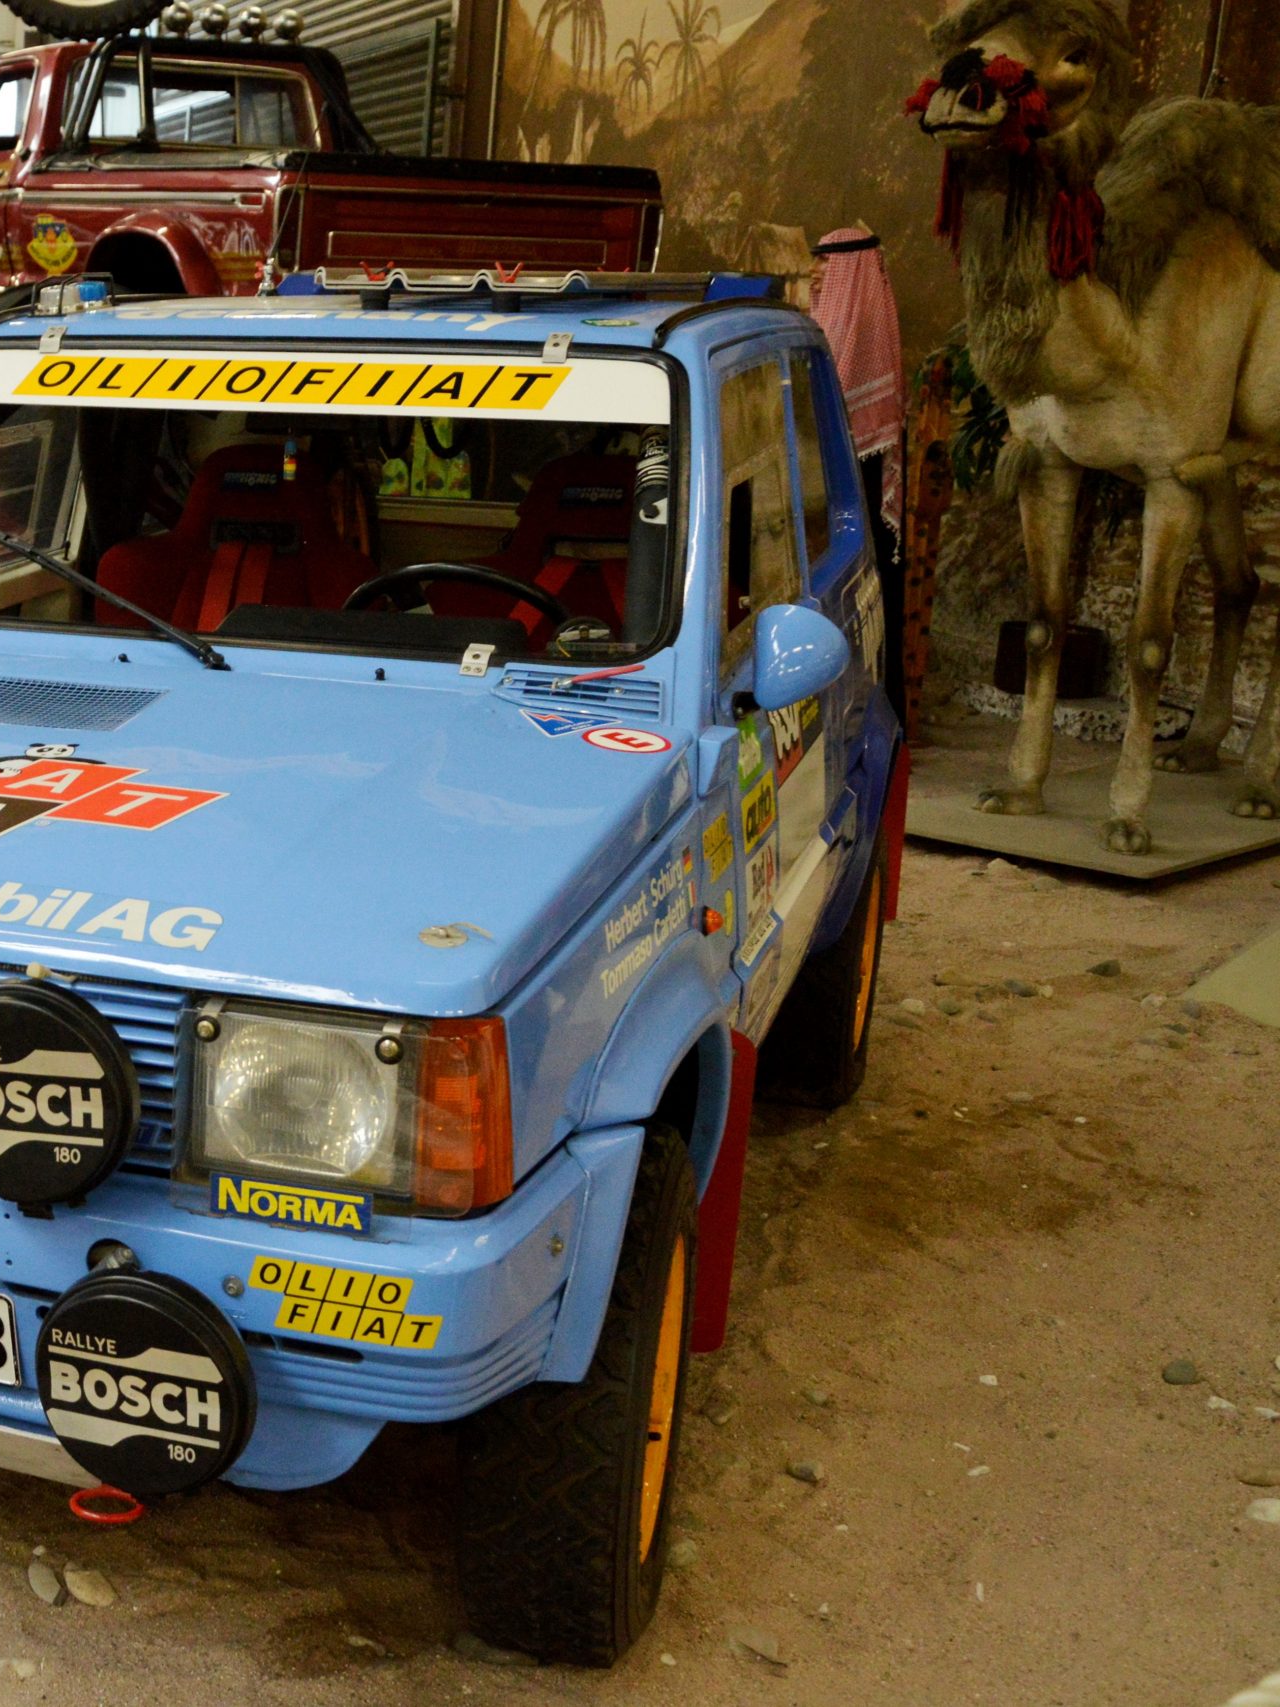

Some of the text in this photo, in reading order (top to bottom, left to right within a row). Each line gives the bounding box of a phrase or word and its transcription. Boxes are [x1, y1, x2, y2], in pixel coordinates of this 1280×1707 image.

[77, 898, 224, 952] AG
[604, 888, 649, 952] Herbert
[600, 936, 653, 999] Tommaso
[53, 1146, 82, 1165] 180
[218, 1176, 365, 1231] NORMA
[259, 1262, 402, 1304] OLIO
[51, 1328, 118, 1356] RALLYE
[287, 1303, 433, 1343] FIAT
[48, 1361, 221, 1433] BOSCH
[166, 1444, 198, 1464] 180
